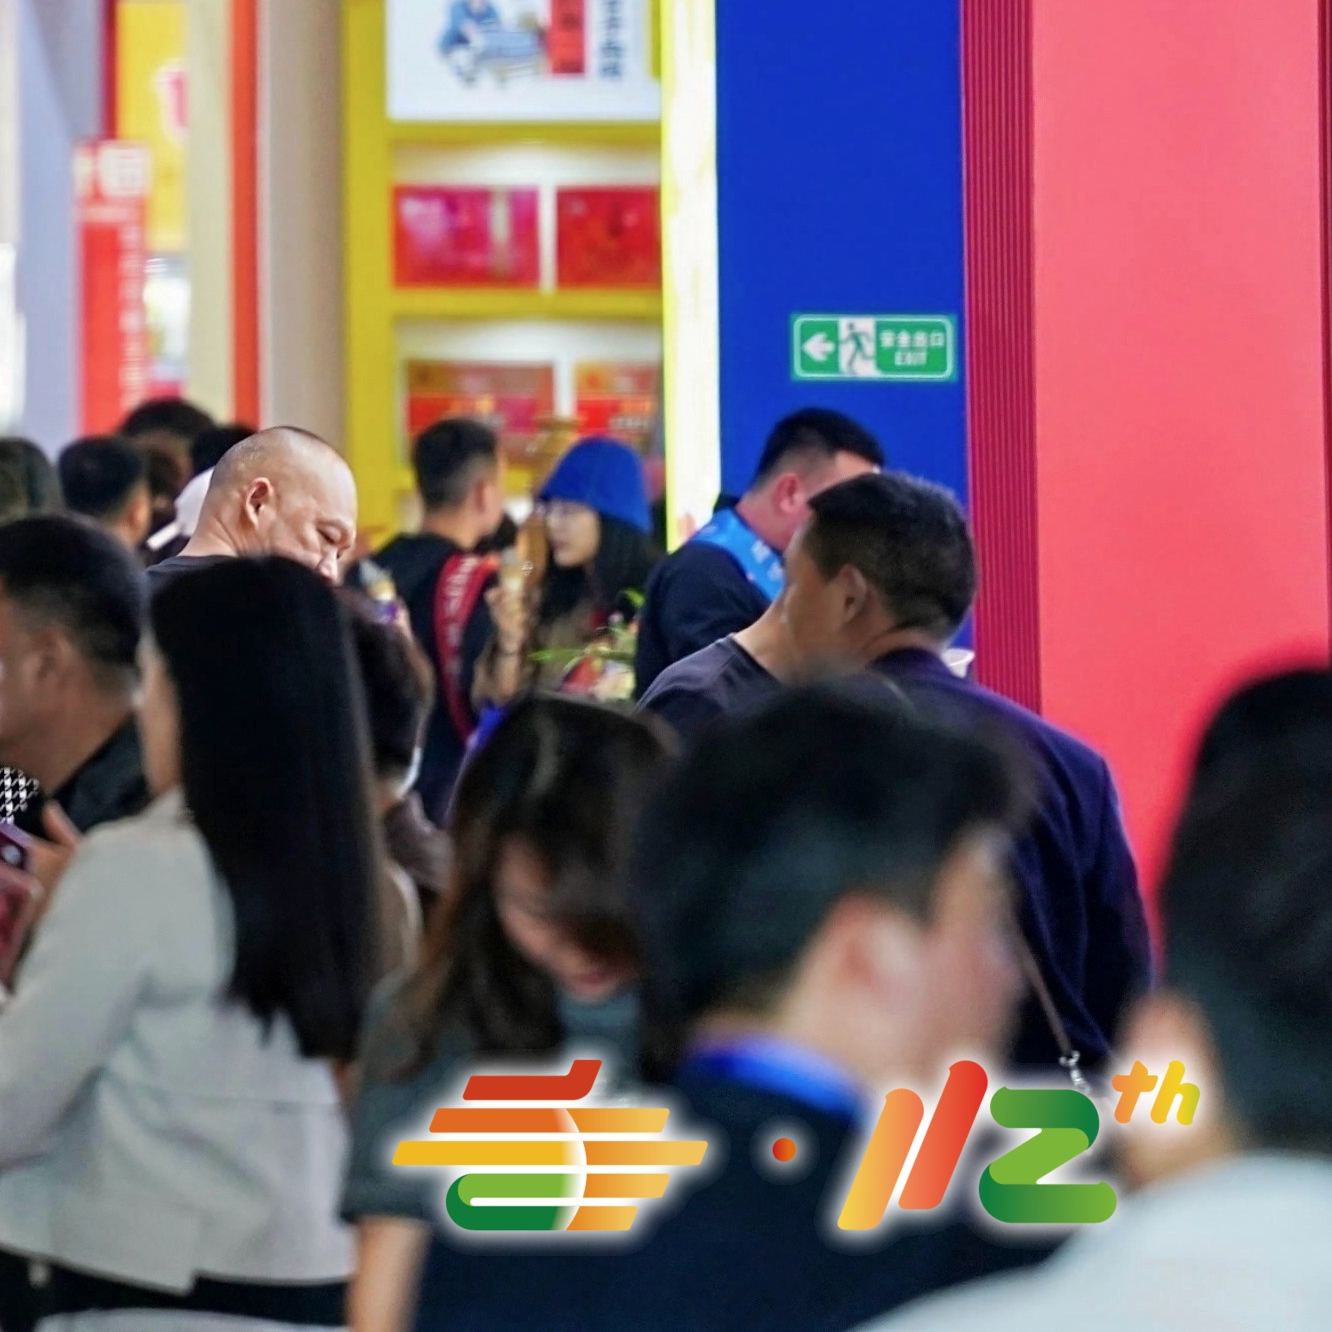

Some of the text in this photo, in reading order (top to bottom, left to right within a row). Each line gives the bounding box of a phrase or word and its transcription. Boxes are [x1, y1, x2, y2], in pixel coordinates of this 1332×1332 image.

[880, 330, 945, 348] 安全出口
[894, 351, 928, 366] EXIT
